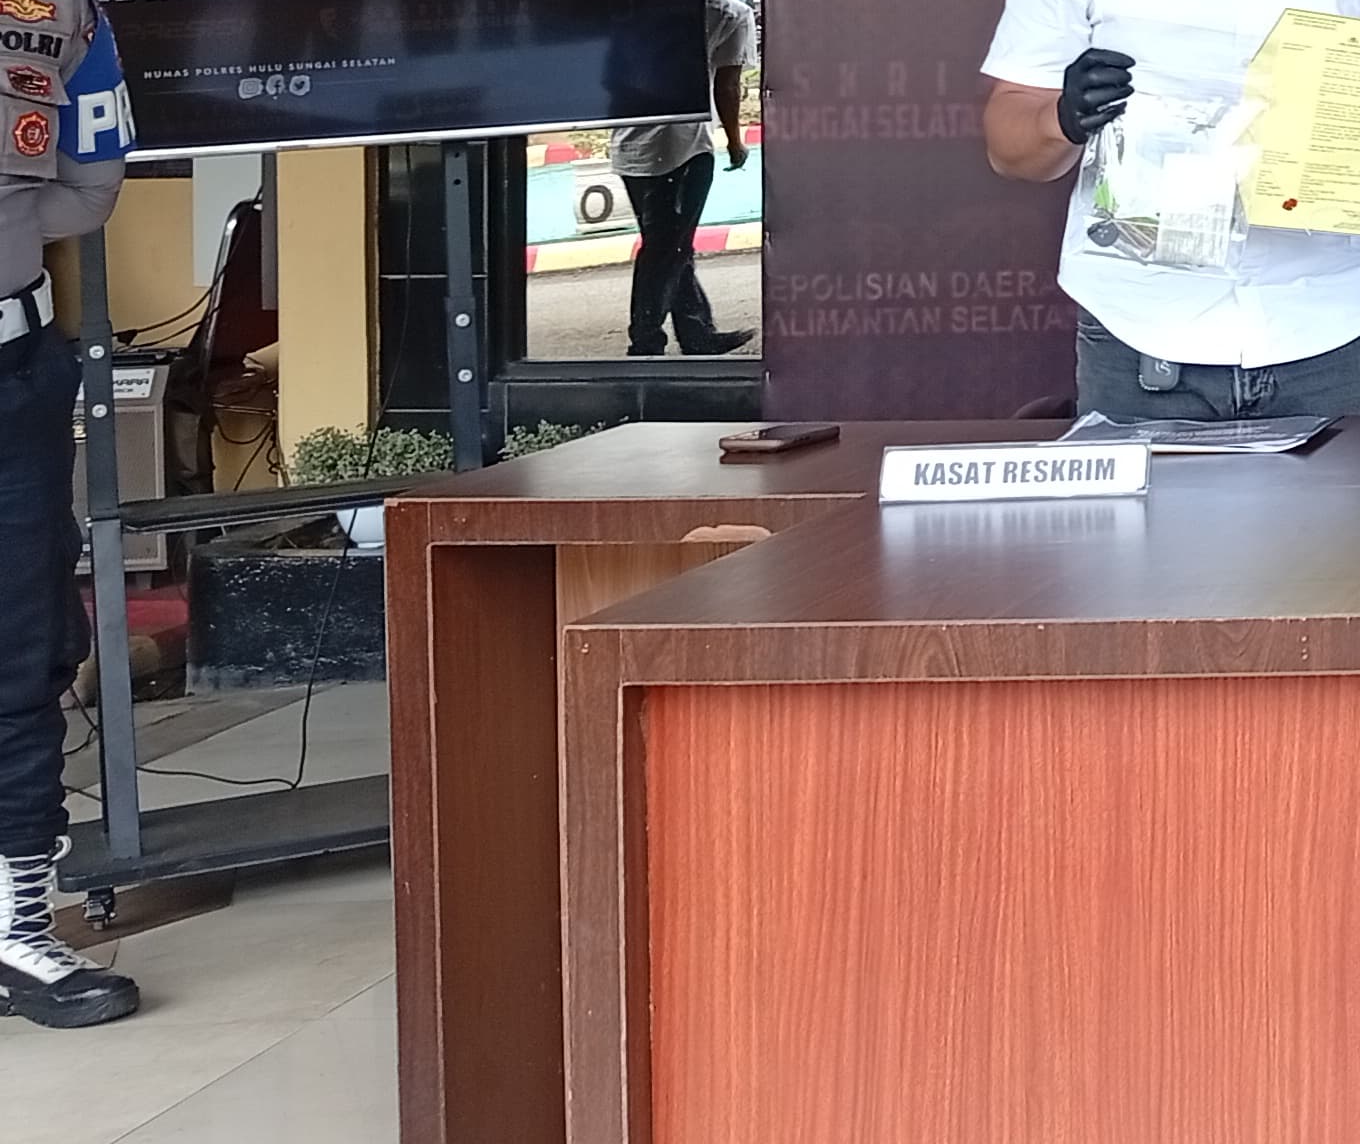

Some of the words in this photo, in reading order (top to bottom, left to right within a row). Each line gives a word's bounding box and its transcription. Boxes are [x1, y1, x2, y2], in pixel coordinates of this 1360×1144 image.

[144, 68, 190, 80] HUMAS
[195, 65, 243, 77] POLRES
[249, 63, 283, 74] HULU
[288, 60, 337, 71] SUNGAI
[342, 58, 397, 69] SELATAN
[769, 270, 940, 304] EPOLISIAN
[950, 269, 1057, 301] DAERA
[766, 306, 942, 339] ALIMANTAN
[950, 304, 1077, 335] SELATA
[913, 461, 997, 486] KASAT
[1002, 457, 1116, 484] RESKRIM
